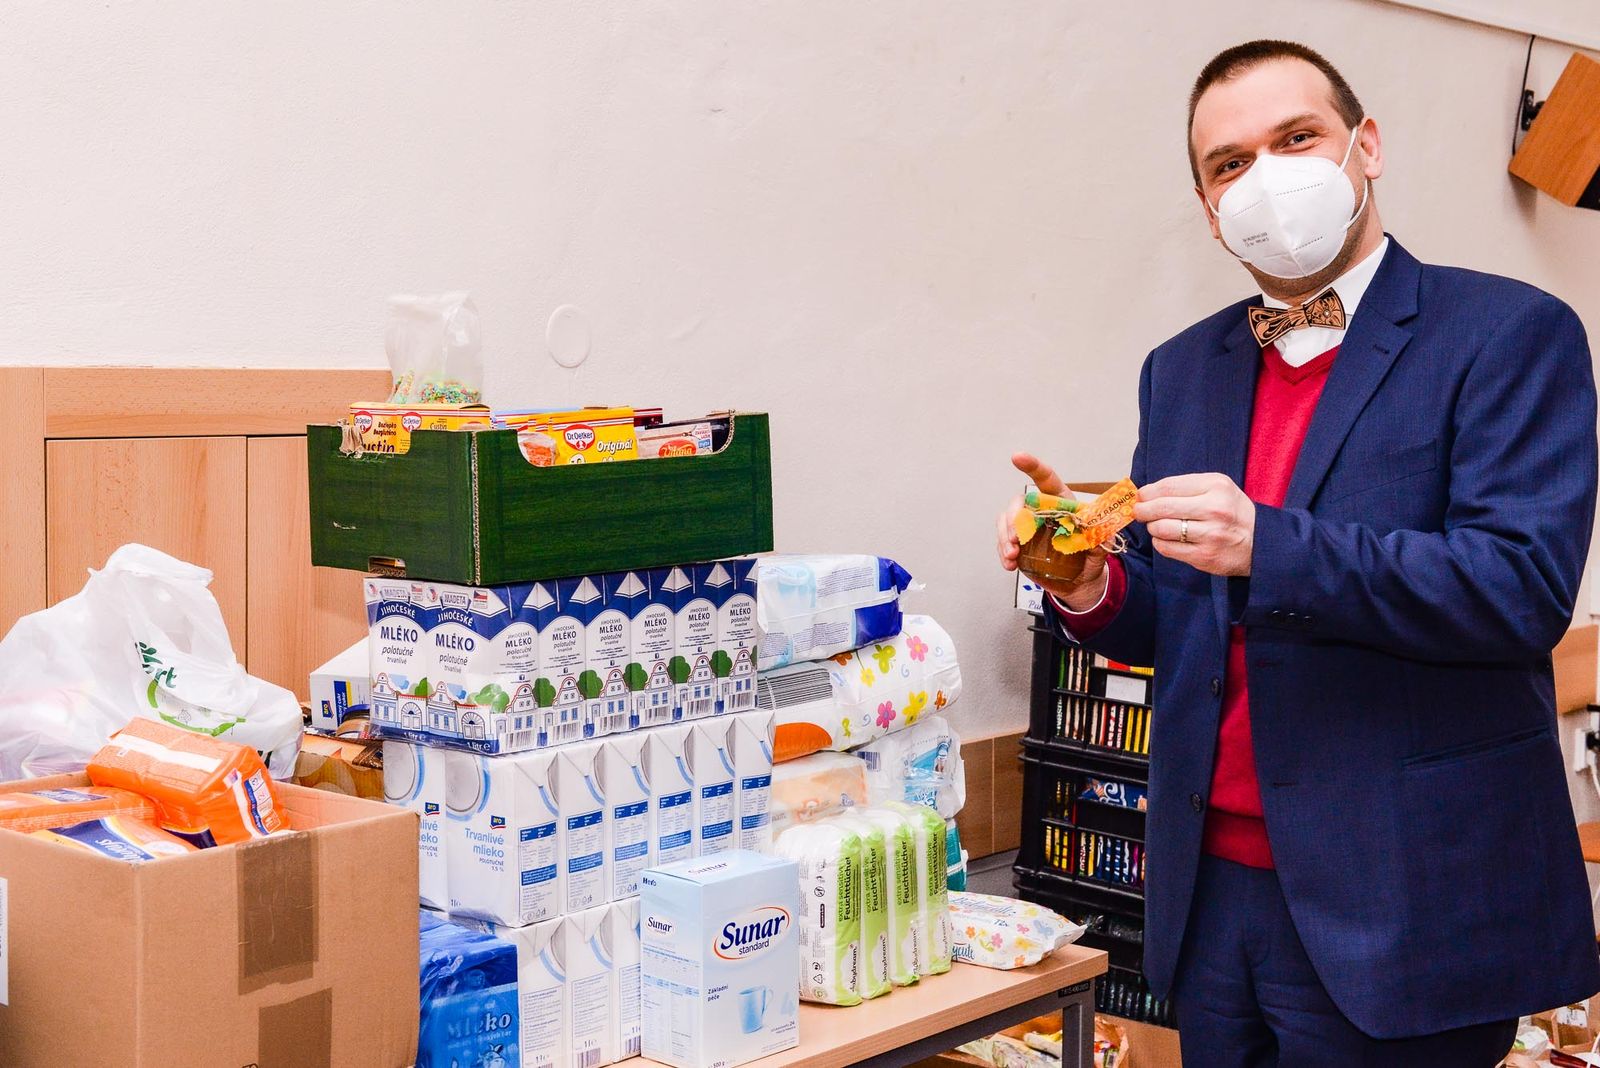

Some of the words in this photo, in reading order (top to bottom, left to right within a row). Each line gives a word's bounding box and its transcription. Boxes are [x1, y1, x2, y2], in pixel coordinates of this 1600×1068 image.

[363, 440, 395, 453] ustin
[1103, 491, 1136, 515] RADNICE
[380, 604, 416, 619] JIHOČESKÉ
[437, 610, 474, 627] JIHOČESKÉ
[688, 612, 711, 621] MLÉKO
[730, 608, 751, 616] MLÉKO
[599, 624, 623, 634] MLÉKO
[644, 618, 668, 627] MLÉKO
[380, 625, 418, 643] MLÉKO
[552, 630, 577, 641] MLÉKO
[435, 633, 476, 652] MLÉKO
[505, 637, 532, 648] MLÉKO
[381, 645, 414, 657] polotučné
[439, 653, 469, 666] polotučné
[421, 821, 438, 832] livé
[421, 834, 439, 845] eko
[465, 828, 505, 845] Trvanlivé
[473, 843, 505, 858] mlieko
[688, 861, 728, 875] Sunar
[932, 832, 940, 895] Feuchttücher
[869, 847, 879, 912] Feuchttücher
[901, 840, 910, 904] Feuchttücher
[837, 901, 845, 922] extra
[648, 916, 673, 933] Sunar
[720, 914, 786, 950] Sunar
[739, 938, 770, 956] standard
